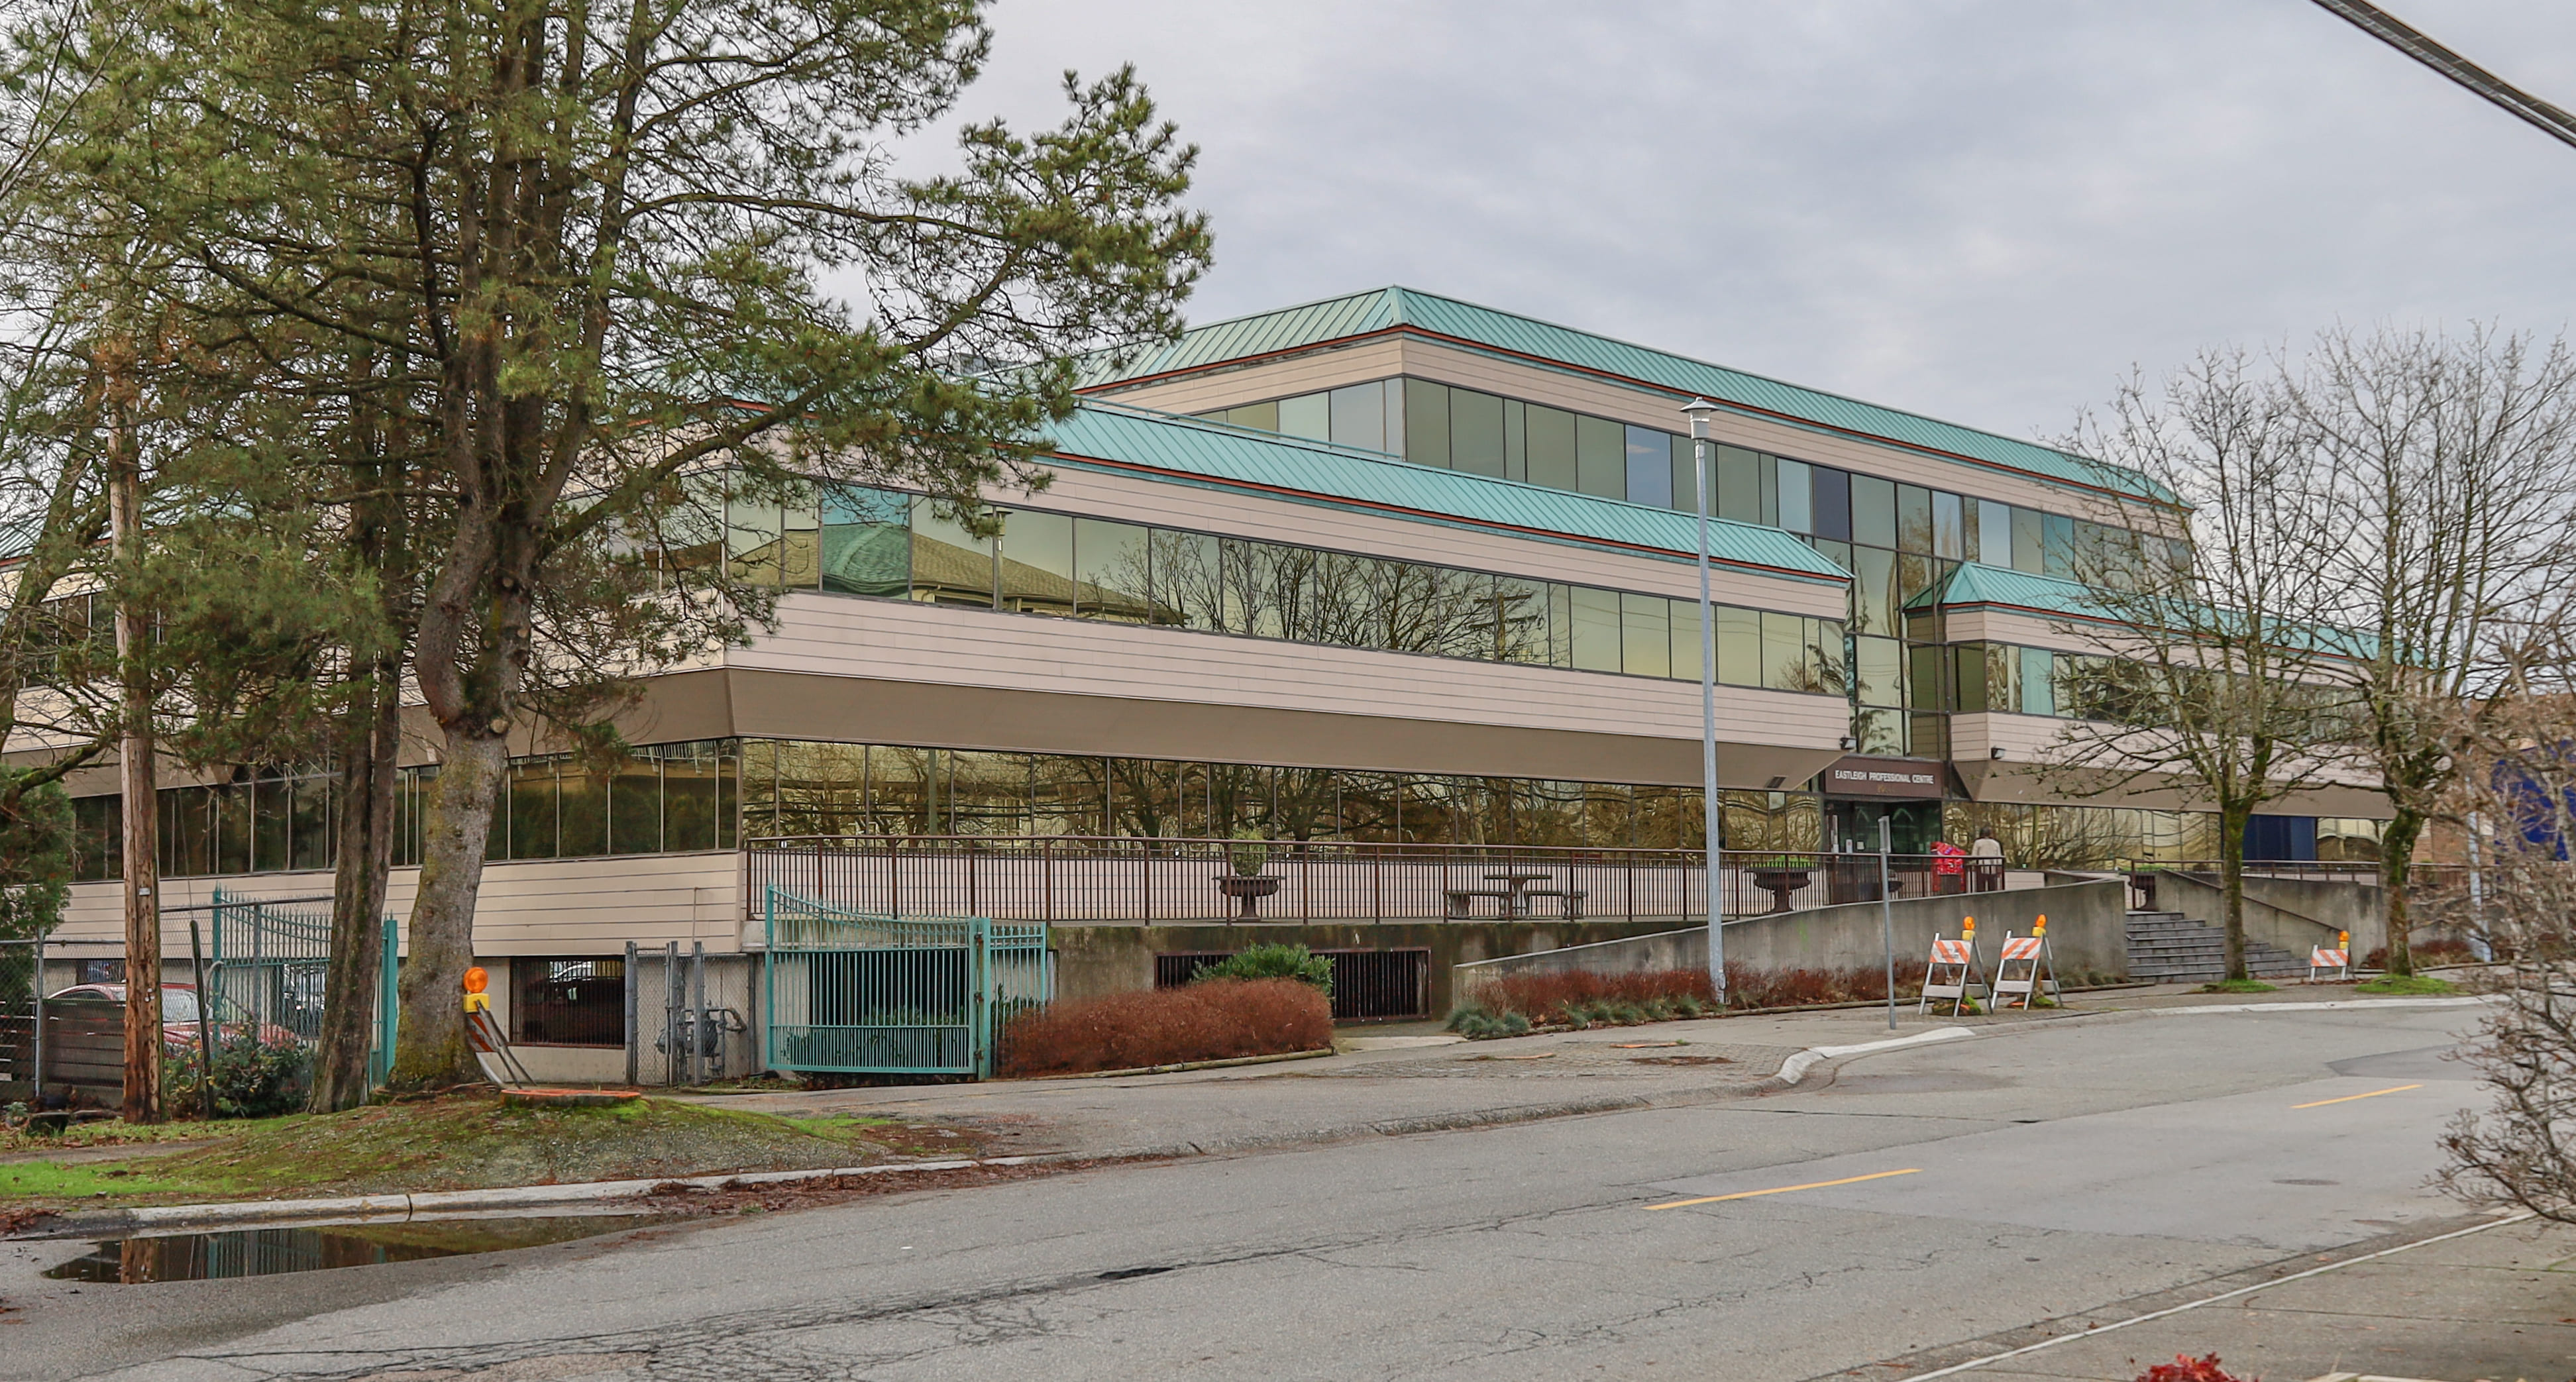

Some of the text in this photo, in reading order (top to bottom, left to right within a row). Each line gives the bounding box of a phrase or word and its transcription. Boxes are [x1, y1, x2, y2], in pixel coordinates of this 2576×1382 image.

[1835, 770, 1935, 784] EASTLEIGH PROFESSIONAL CENTRE
